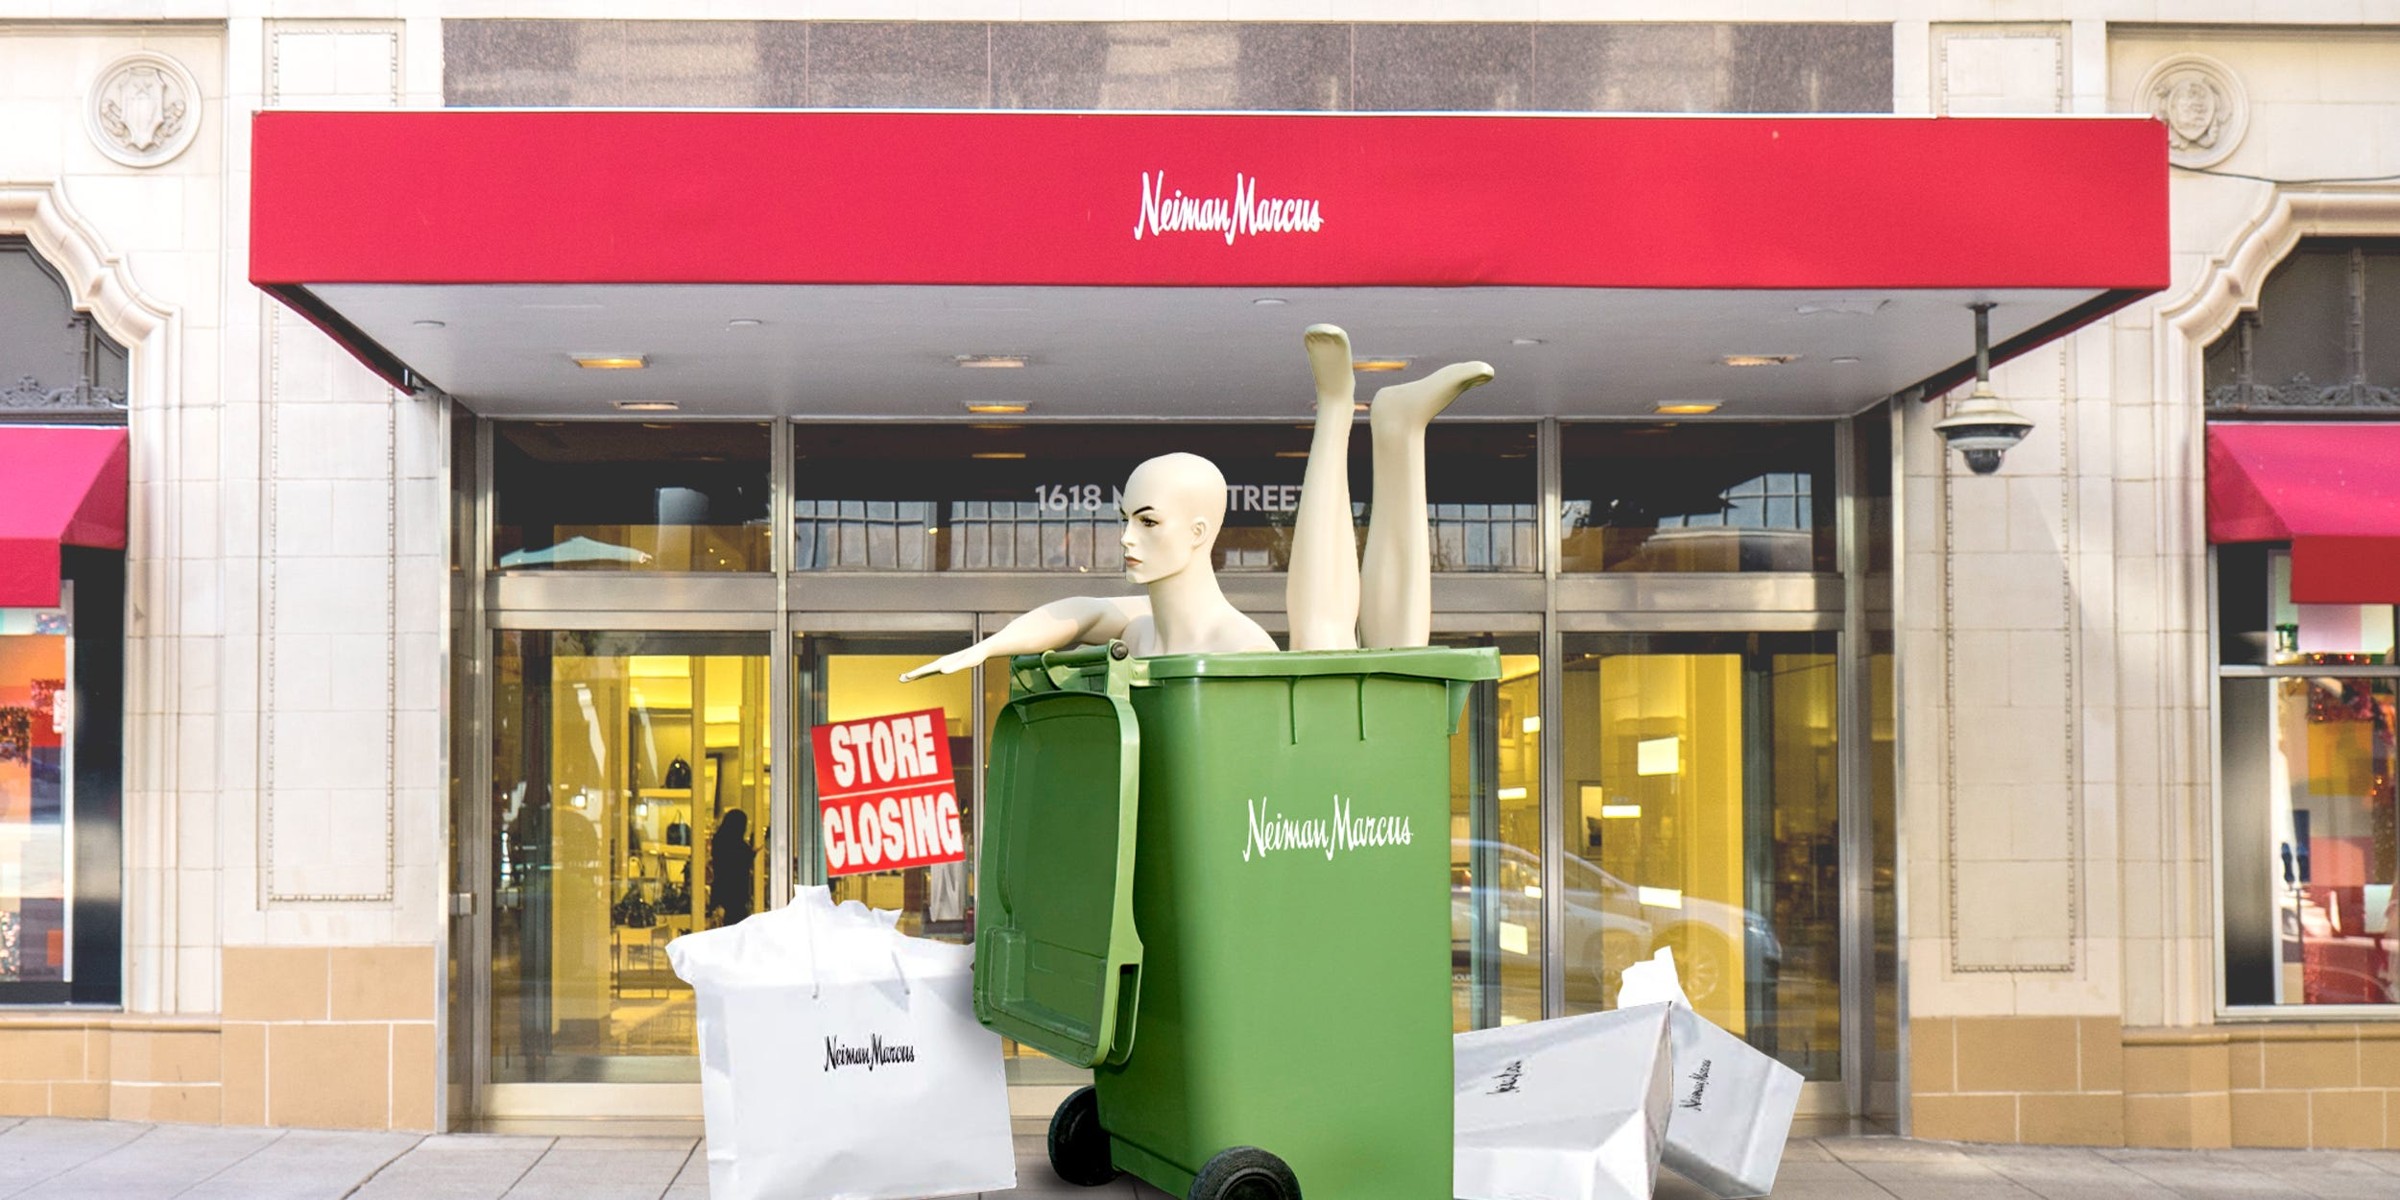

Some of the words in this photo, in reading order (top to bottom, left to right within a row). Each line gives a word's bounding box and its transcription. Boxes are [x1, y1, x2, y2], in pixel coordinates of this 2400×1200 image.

[1133, 169, 1231, 241] Neiman
[1224, 172, 1325, 246] Marcus
[1035, 484, 1102, 511] 1618
[1226, 484, 1304, 511] TREE
[829, 714, 938, 788] STORE
[823, 792, 964, 869] CLOSING
[1242, 796, 1329, 862] Neiman
[1325, 794, 1413, 861] Marcus
[823, 1035, 870, 1072] Neiman
[868, 1033, 915, 1072] Marcus
